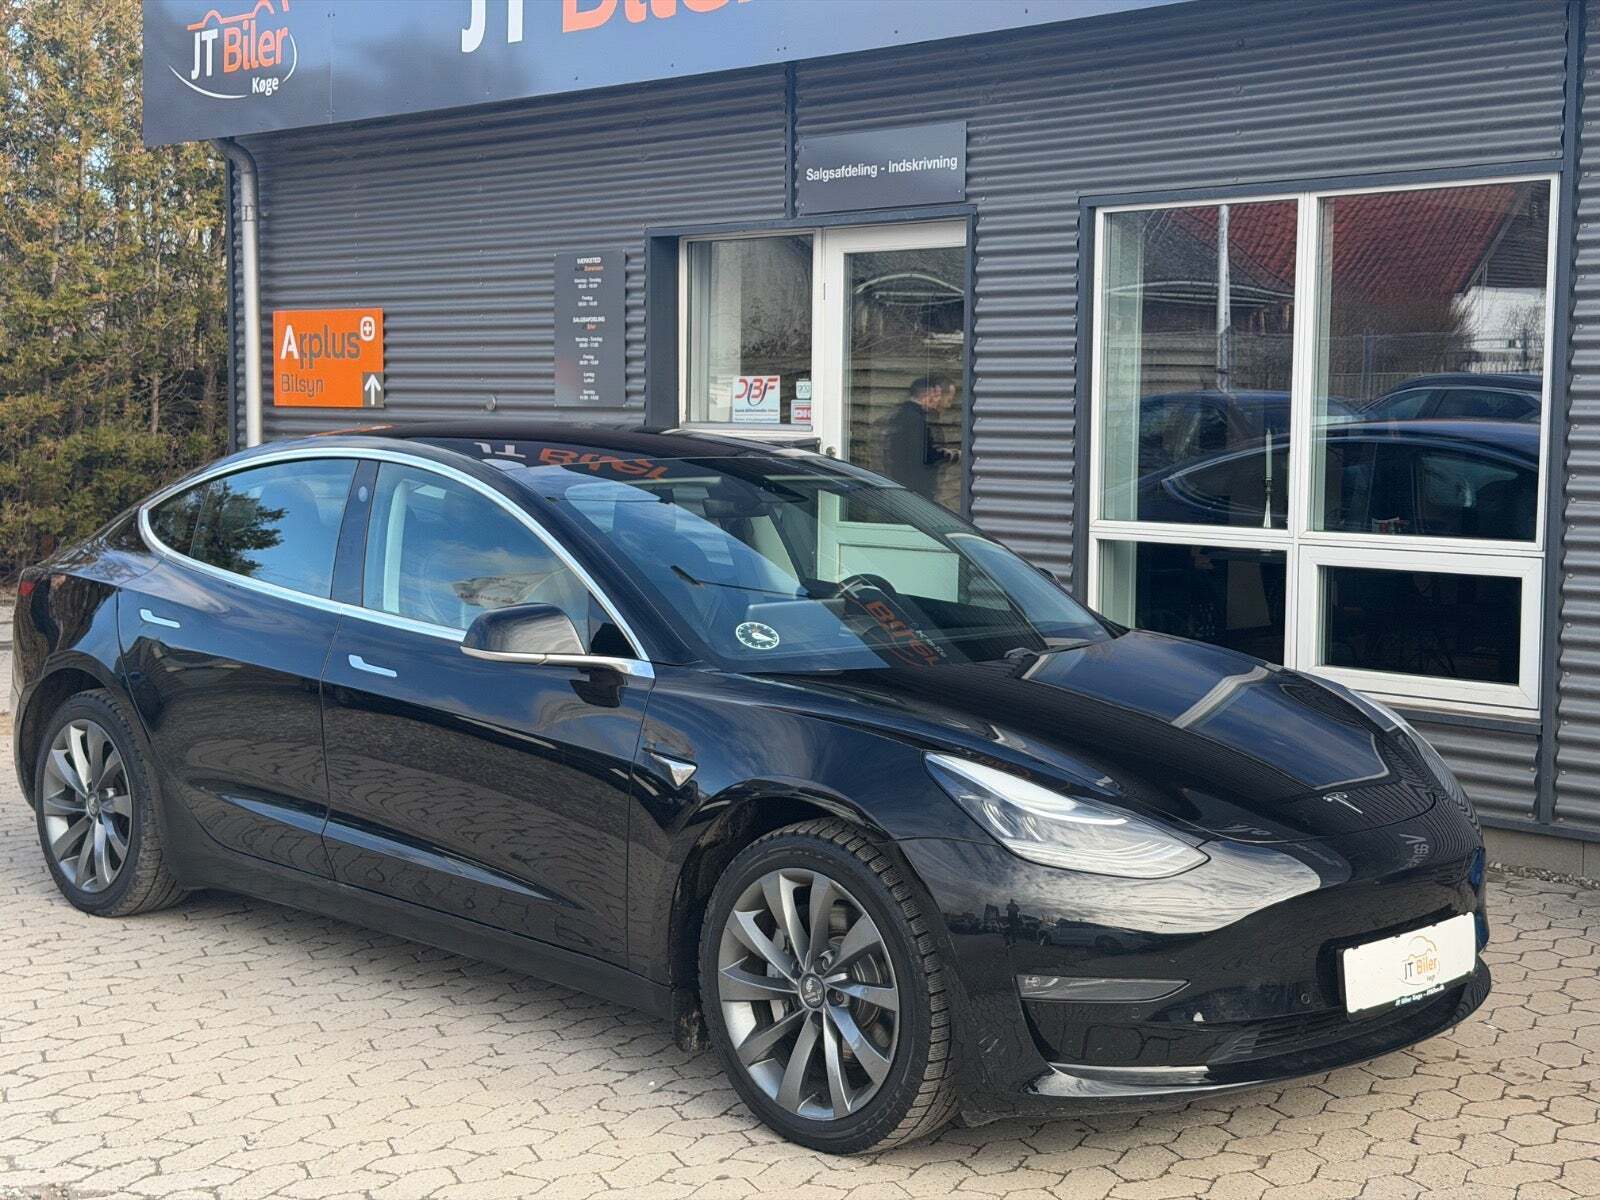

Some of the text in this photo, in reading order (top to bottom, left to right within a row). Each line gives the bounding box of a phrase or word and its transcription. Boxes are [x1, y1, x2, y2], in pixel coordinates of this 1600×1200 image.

[191, 19, 289, 80] JT Biler
[252, 77, 279, 96] Køge
[806, 163, 878, 183] Salgsafdeling
[888, 155, 958, 173] Indskrivning
[281, 374, 324, 398] Bilsyn
